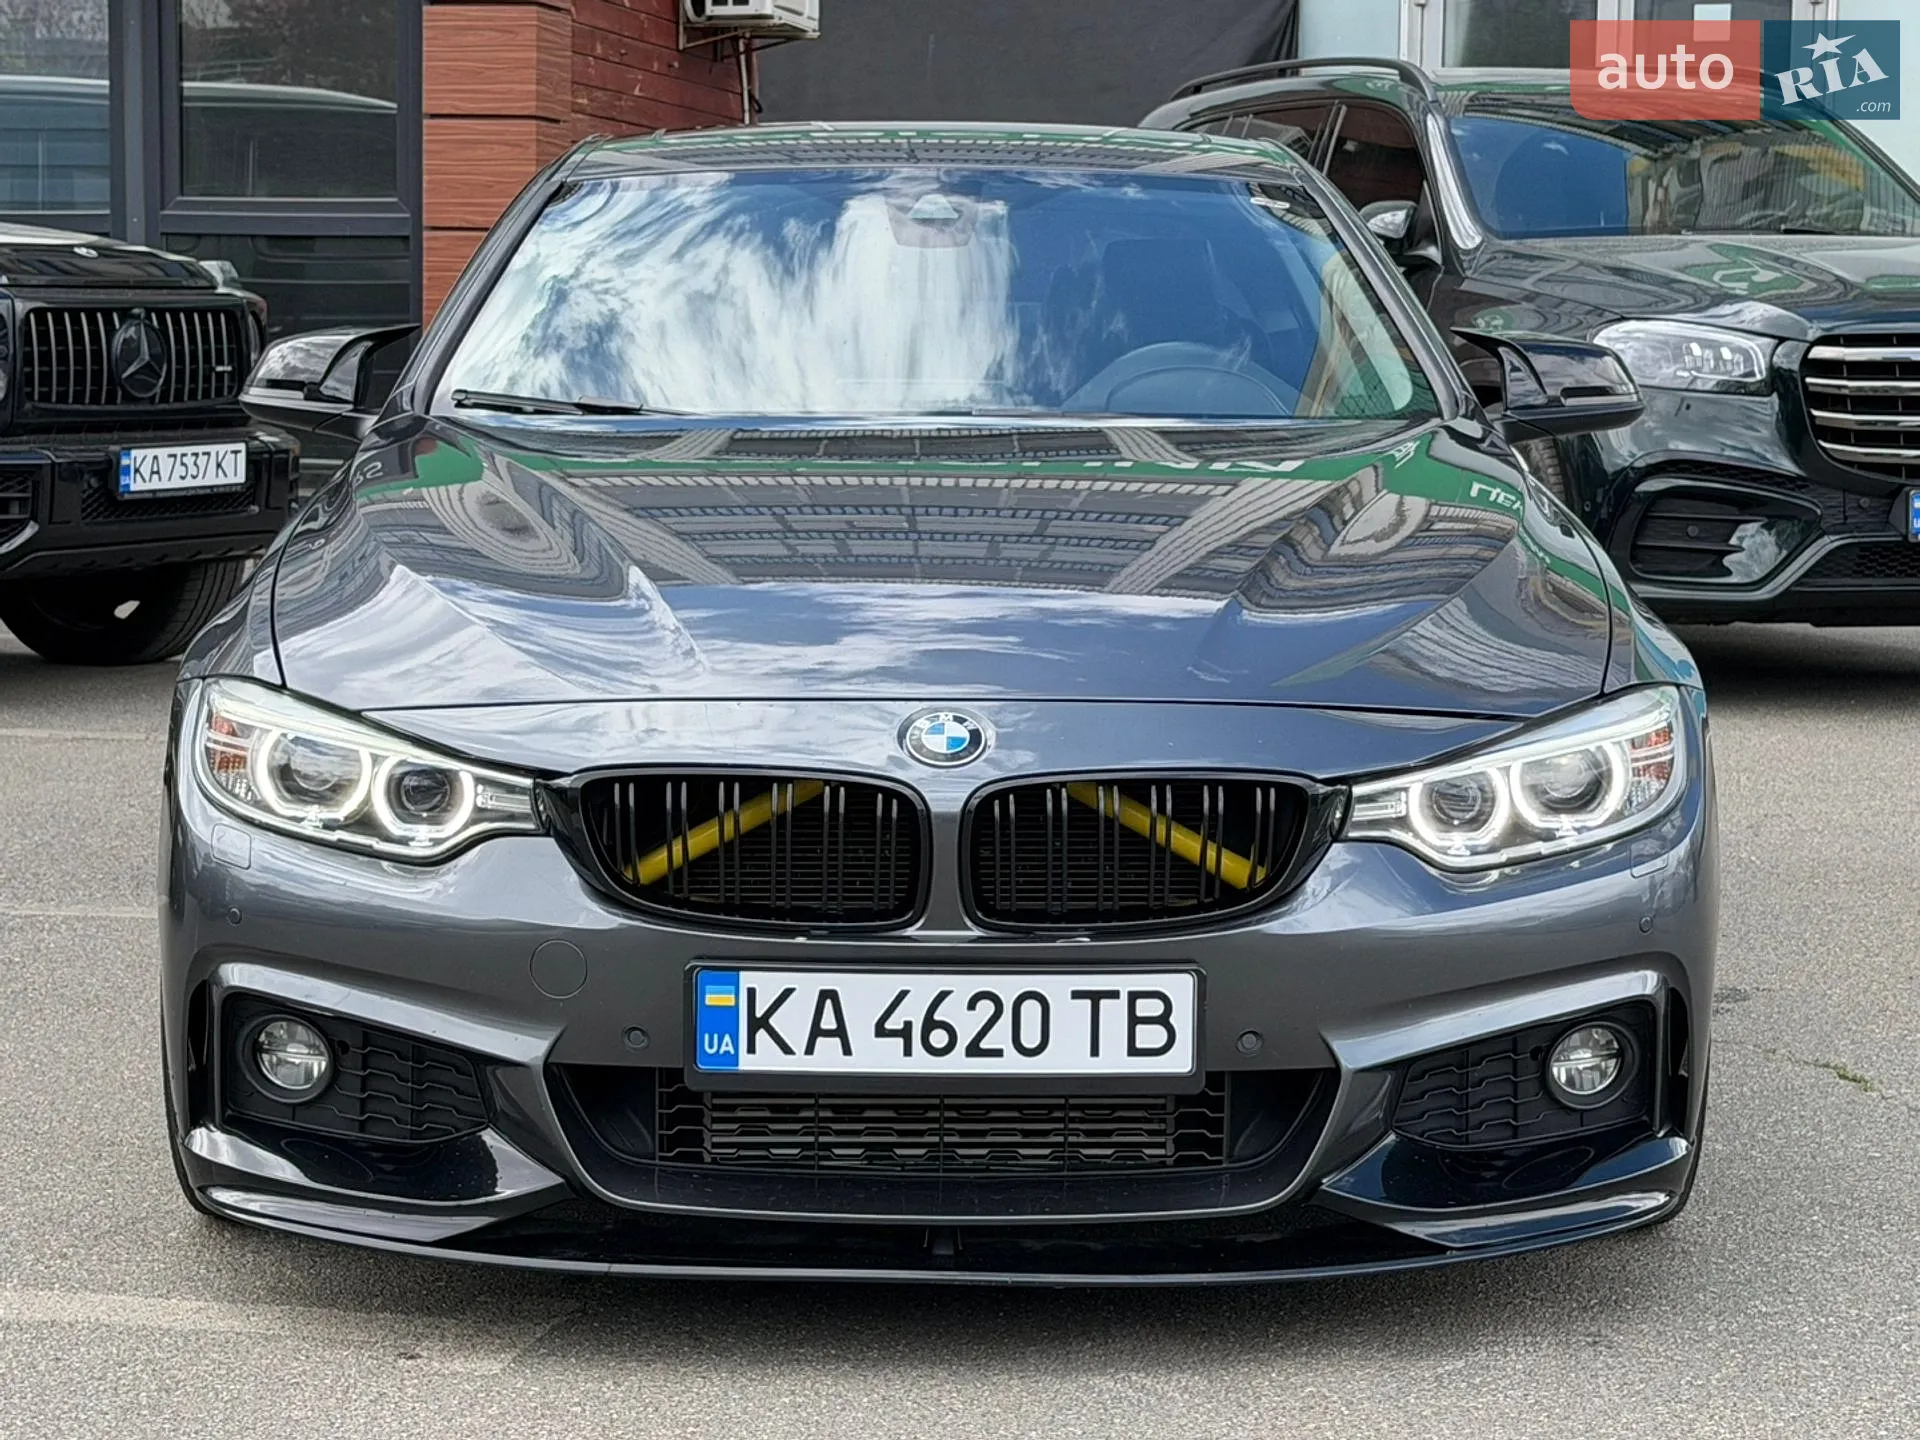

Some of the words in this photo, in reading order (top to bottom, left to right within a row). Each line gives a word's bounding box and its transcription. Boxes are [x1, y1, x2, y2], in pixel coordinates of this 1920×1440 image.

[133, 454, 162, 484] KA
[167, 452, 211, 482] 7537
[215, 450, 242, 478] KT
[915, 712, 978, 730] BMW
[746, 987, 853, 1057] KA
[873, 989, 1052, 1058] 4620
[1070, 989, 1178, 1058] TB
[704, 1032, 735, 1055] UA
